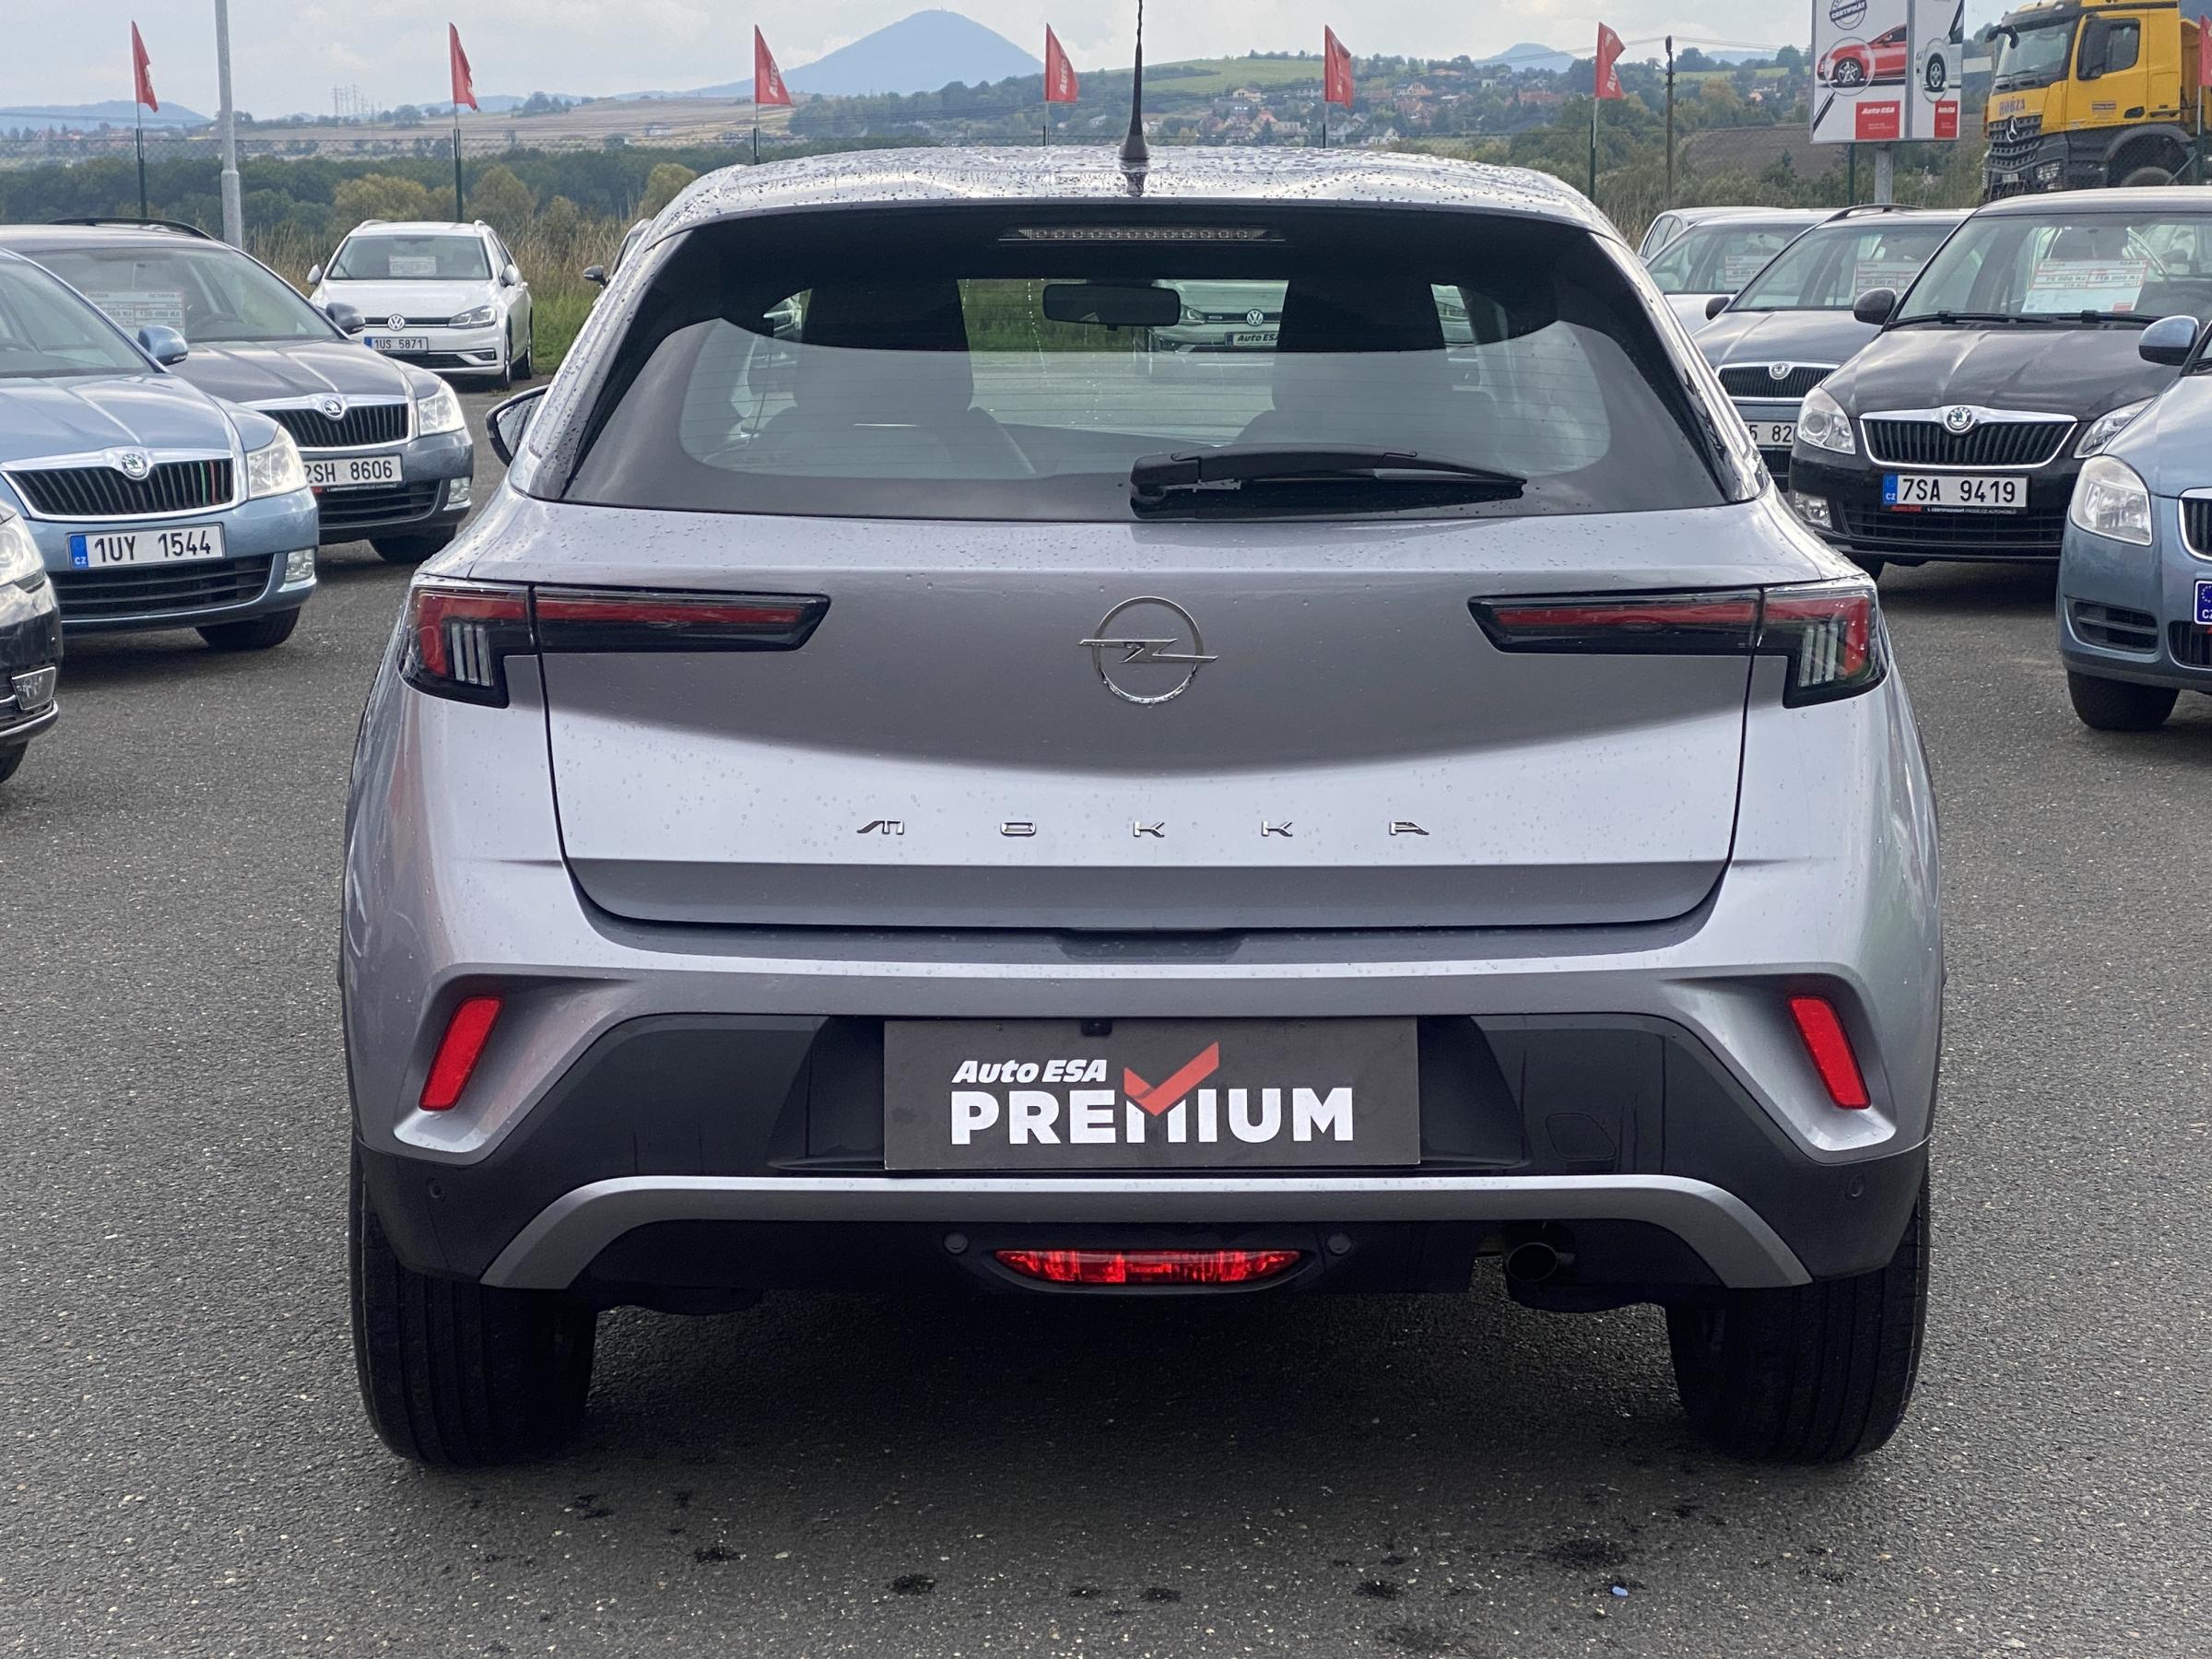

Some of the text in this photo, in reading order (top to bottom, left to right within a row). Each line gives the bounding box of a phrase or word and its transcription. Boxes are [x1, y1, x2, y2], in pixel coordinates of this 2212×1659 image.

[374, 339, 423, 349] 1US 5871
[350, 460, 393, 480] 8606
[1902, 478, 2016, 503] 7SA 9419
[94, 530, 212, 563] 1UY 1544
[74, 557, 88, 565] CZ
[856, 819, 1430, 838] MOKKA
[951, 1059, 1107, 1084] Auto ESA
[951, 1088, 1354, 1145] PREMIUM
